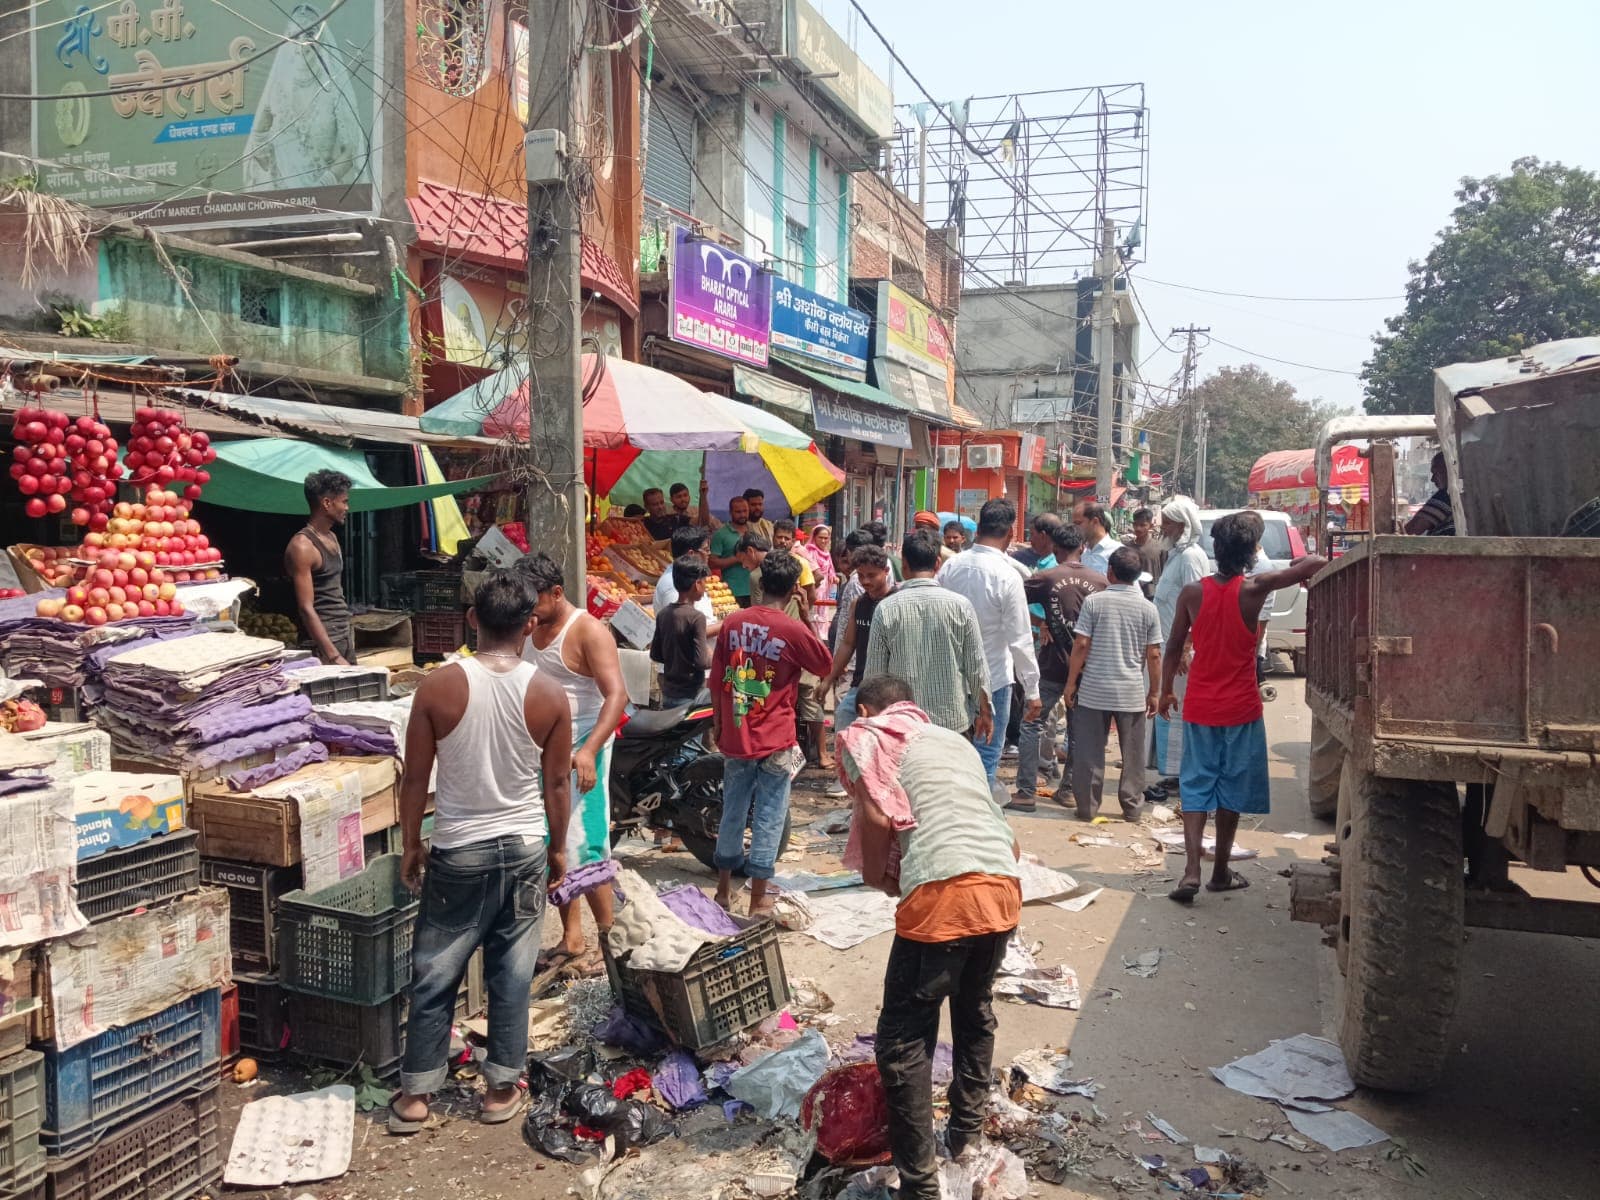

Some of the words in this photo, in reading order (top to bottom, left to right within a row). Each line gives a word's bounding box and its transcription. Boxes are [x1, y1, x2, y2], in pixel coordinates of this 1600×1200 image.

[56, 4, 110, 75] श्री
[46, 167, 80, 189] सोना,
[134, 156, 178, 178] डायमंड
[203, 200, 246, 215] CHANDANI
[701, 274, 726, 298] BHARAT
[726, 285, 749, 309] OPTICAL
[714, 298, 738, 320] ARARIA
[776, 286, 792, 309] श्री
[793, 298, 828, 320] अशोक
[853, 318, 869, 339] स्टोर
[817, 394, 832, 417] श्री
[832, 401, 863, 425] अशोक
[889, 416, 907, 436] स्टोर
[729, 629, 786, 662] ALIVE
[77, 831, 111, 849] Chine
